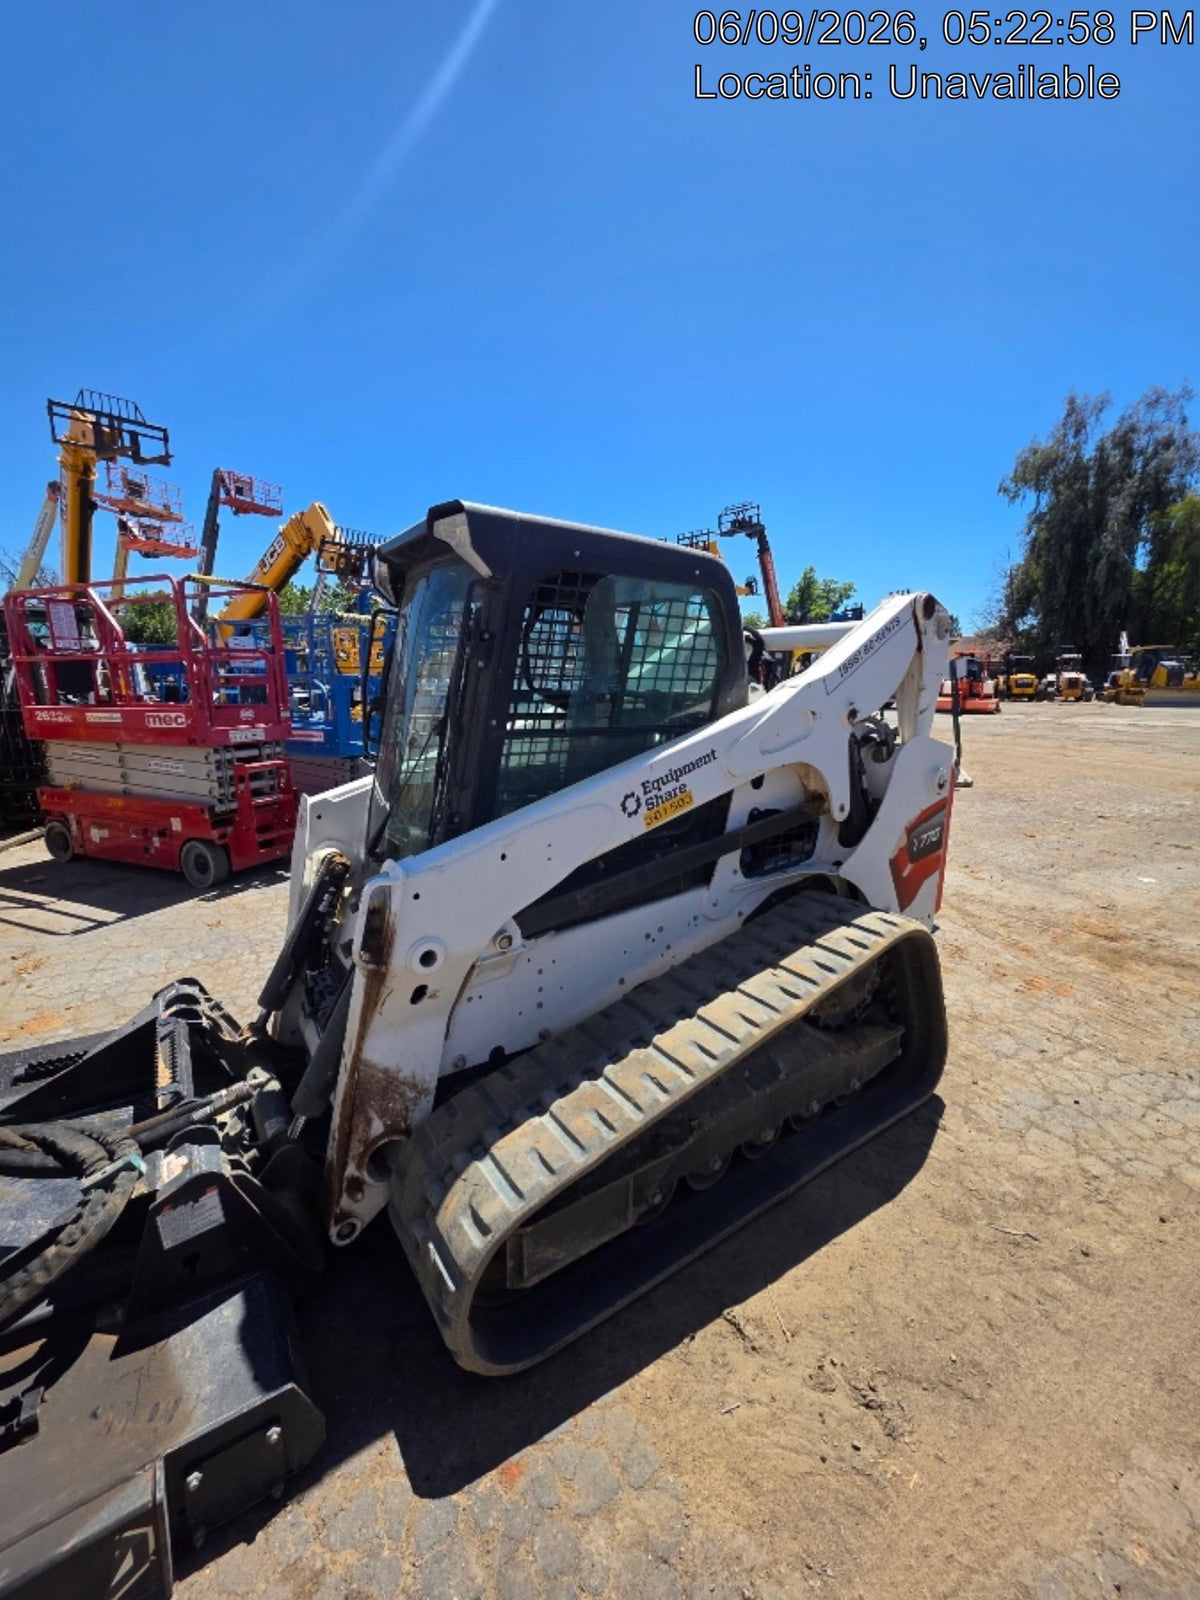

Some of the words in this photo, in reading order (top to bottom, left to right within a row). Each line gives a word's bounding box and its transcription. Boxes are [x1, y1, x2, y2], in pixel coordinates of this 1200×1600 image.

[260, 533, 286, 574] JCB
[641, 748, 718, 795] Equipment
[644, 783, 688, 811] Share
